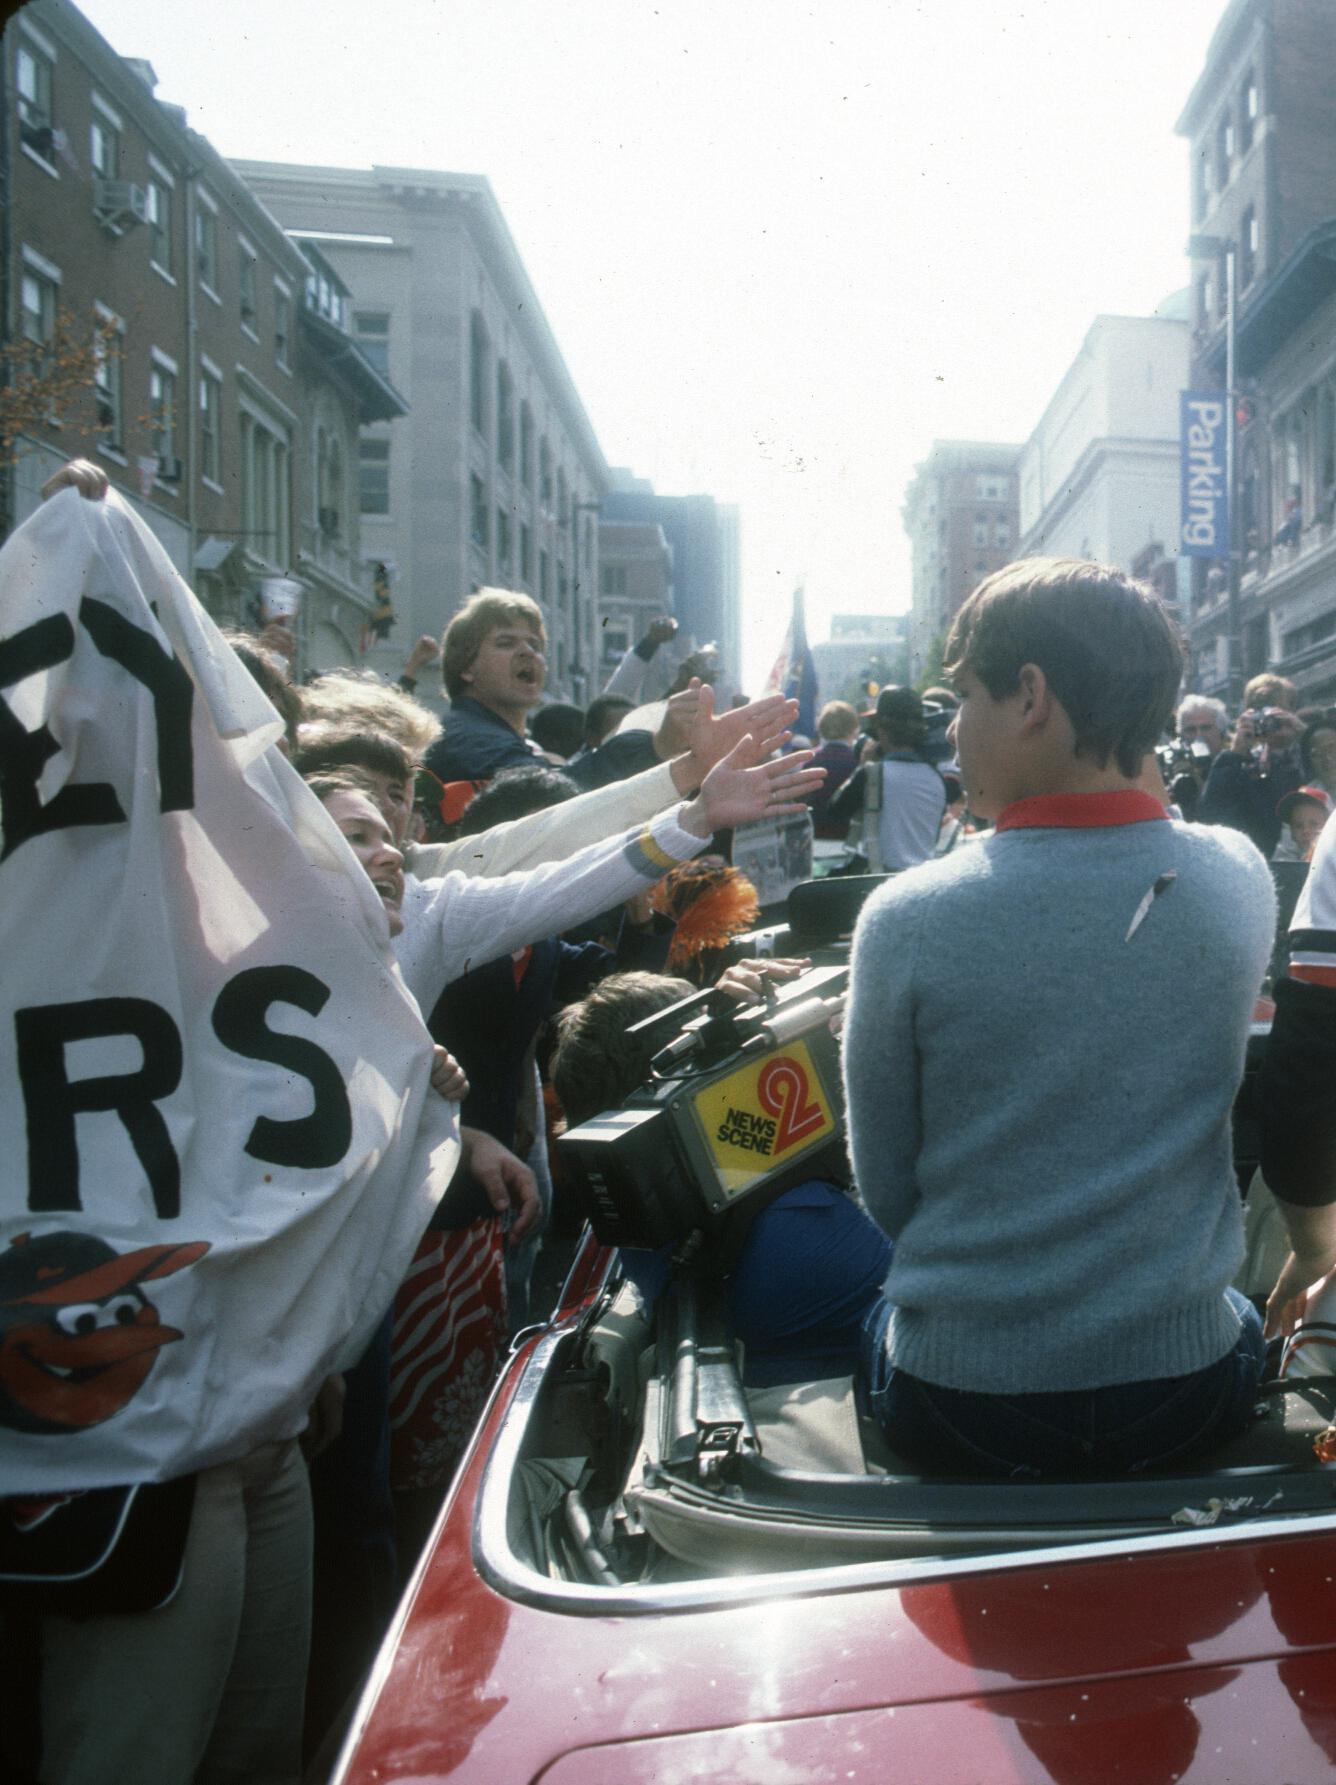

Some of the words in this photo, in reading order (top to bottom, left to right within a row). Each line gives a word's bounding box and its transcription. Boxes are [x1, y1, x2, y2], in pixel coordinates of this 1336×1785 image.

[1184, 401, 1223, 545] Parking
[725, 1107, 777, 1138] NEWS
[757, 1056, 826, 1155] 2
[717, 1124, 774, 1156] SCENE
